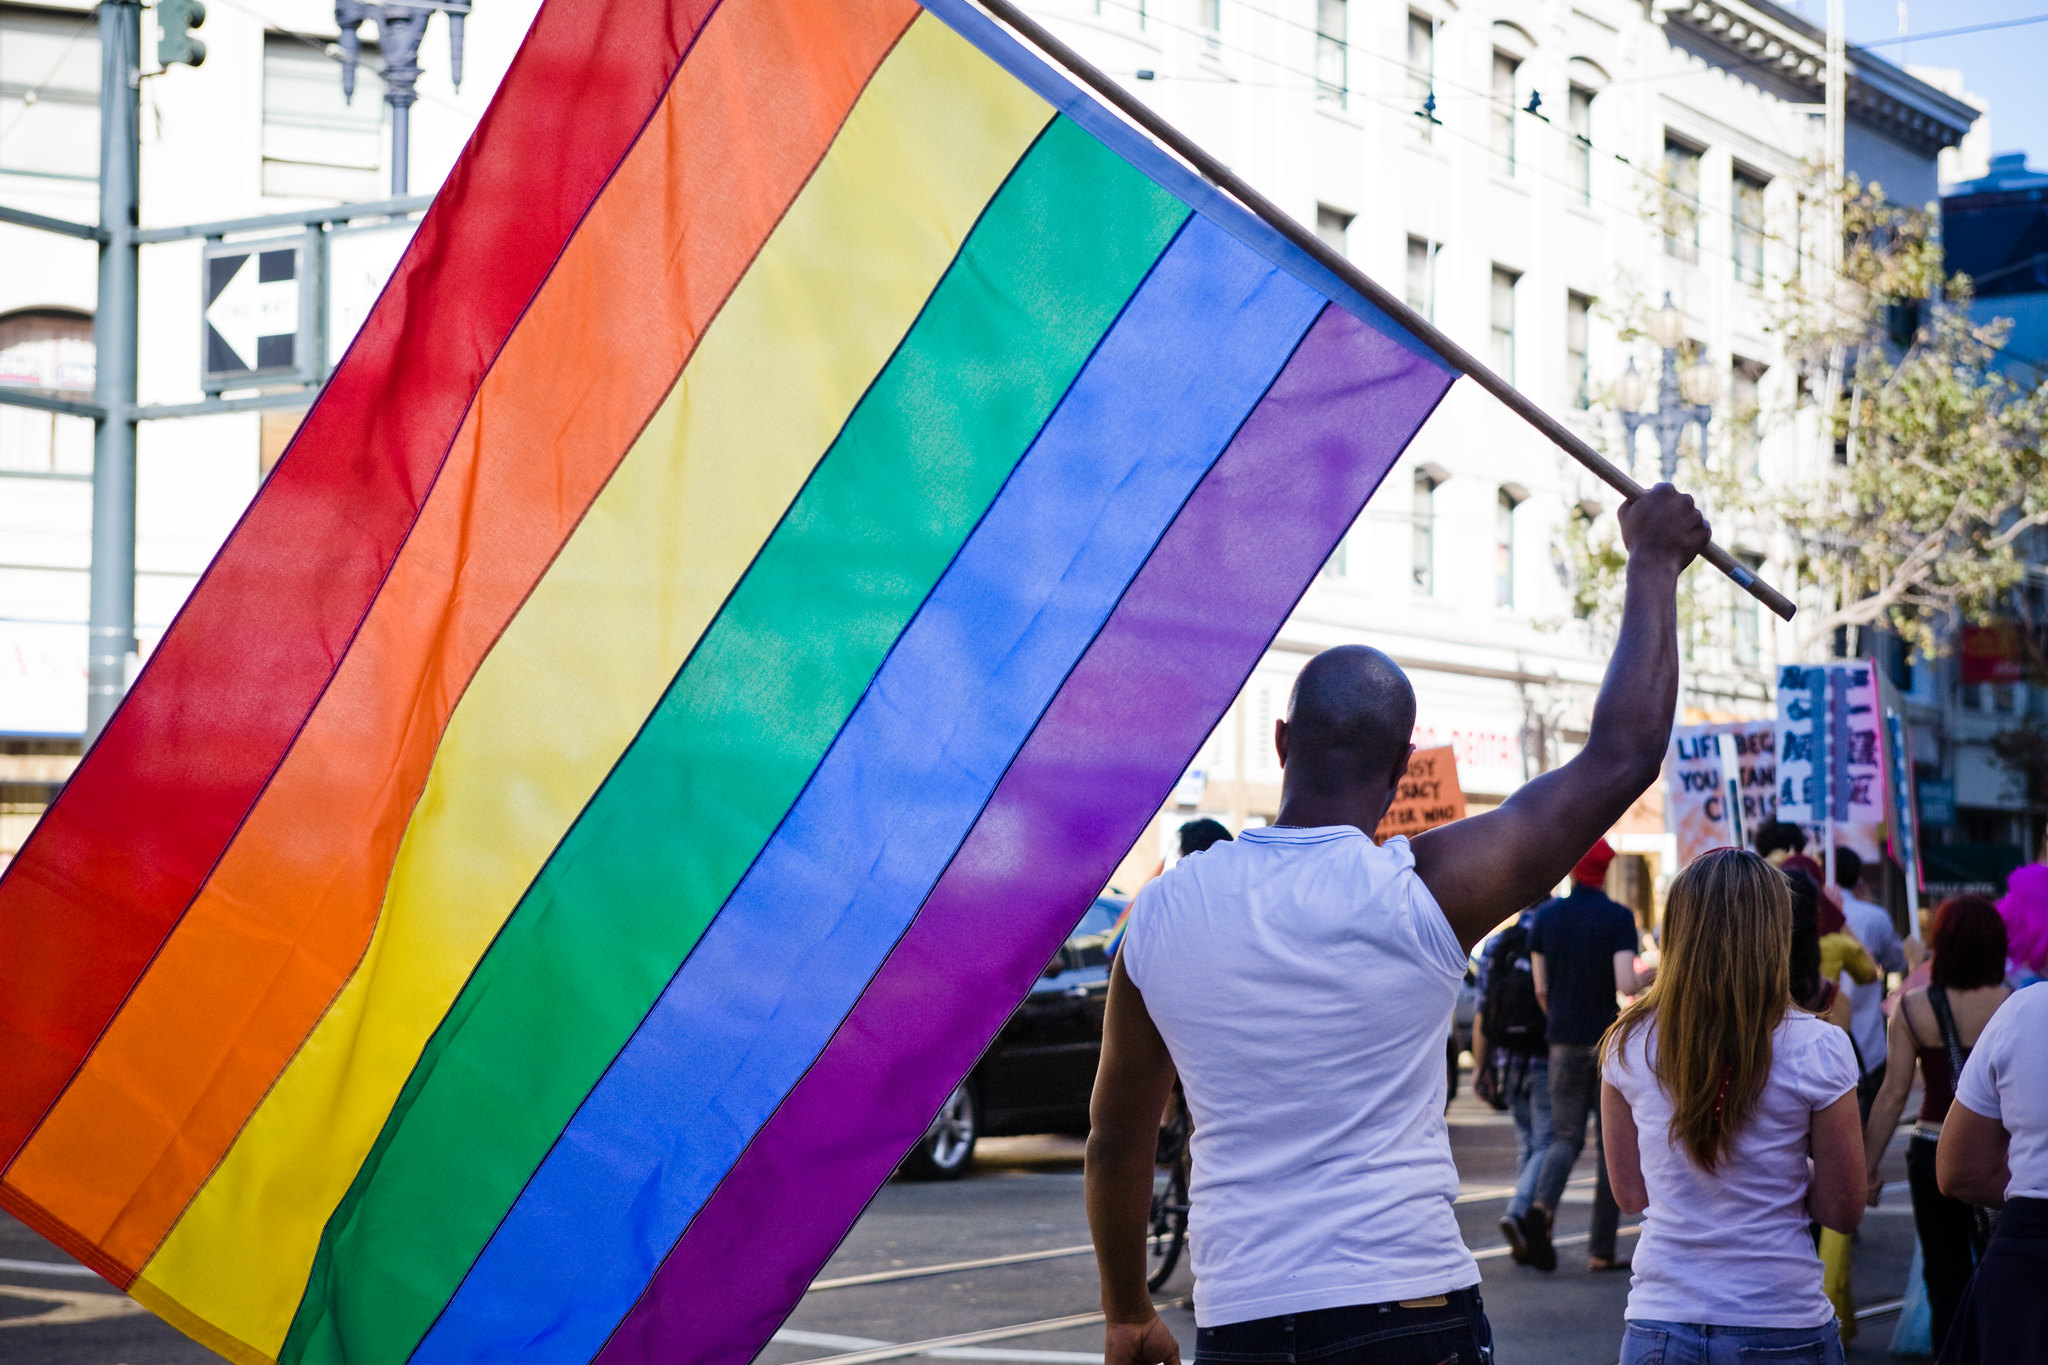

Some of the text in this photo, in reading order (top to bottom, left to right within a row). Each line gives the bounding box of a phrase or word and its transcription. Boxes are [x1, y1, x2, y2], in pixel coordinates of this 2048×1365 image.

[1677, 734, 1721, 760] LIF
[1679, 767, 1719, 792] YOU
[1422, 805, 1455, 823] WHO
